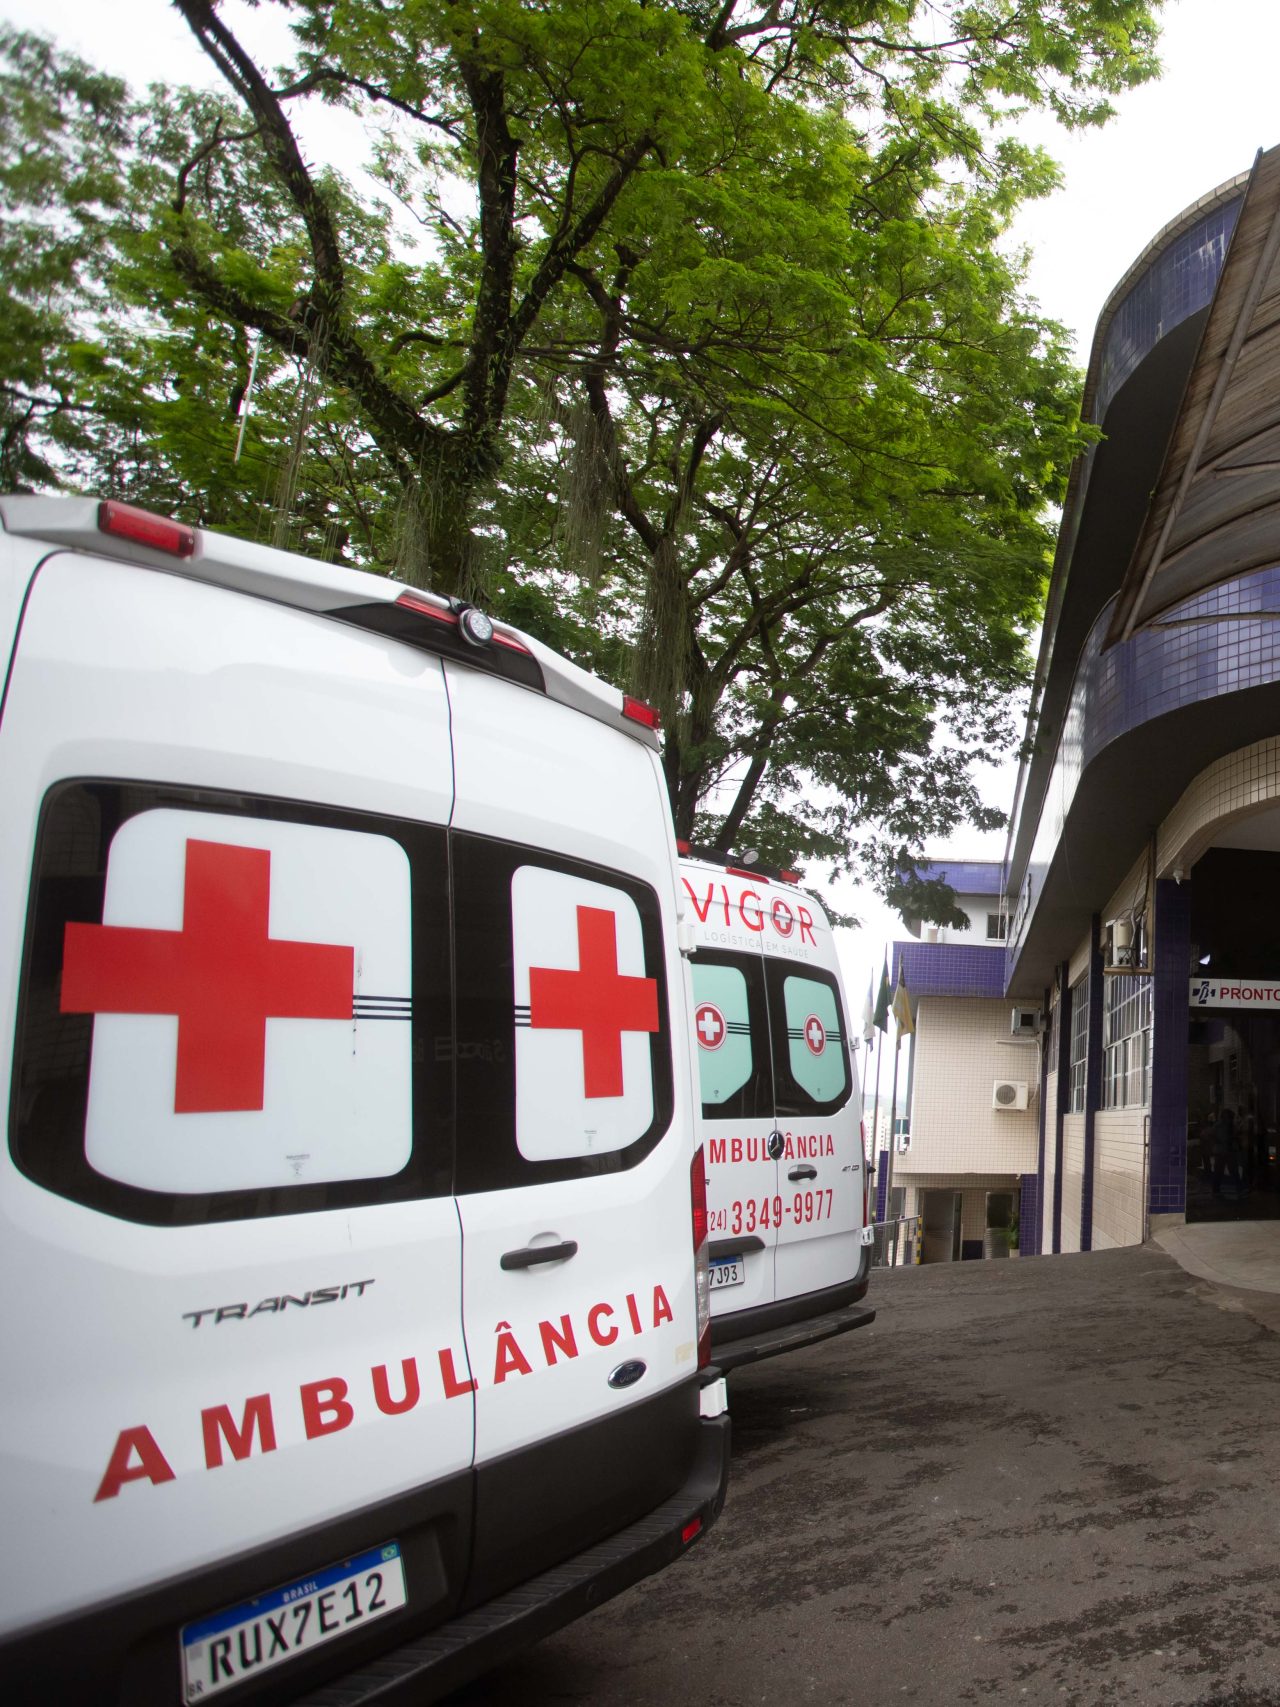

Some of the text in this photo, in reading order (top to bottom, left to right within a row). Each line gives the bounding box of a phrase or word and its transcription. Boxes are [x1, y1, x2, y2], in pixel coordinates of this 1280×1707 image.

[681, 877, 817, 947] VIGOR
[704, 931, 762, 948] LOGÍSTICA
[766, 941, 779, 952] EM
[709, 1132, 834, 1164] MBULÂNCIA
[731, 1189, 833, 1235] 3349-9977
[709, 1265, 738, 1286] 7J93
[182, 1279, 376, 1329] TRANSIT
[93, 1284, 674, 1503] AMBULÂNCIA
[282, 1581, 319, 1603] BRASIL
[209, 1572, 387, 1684] RUX7E12
[189, 1680, 204, 1698] BR
